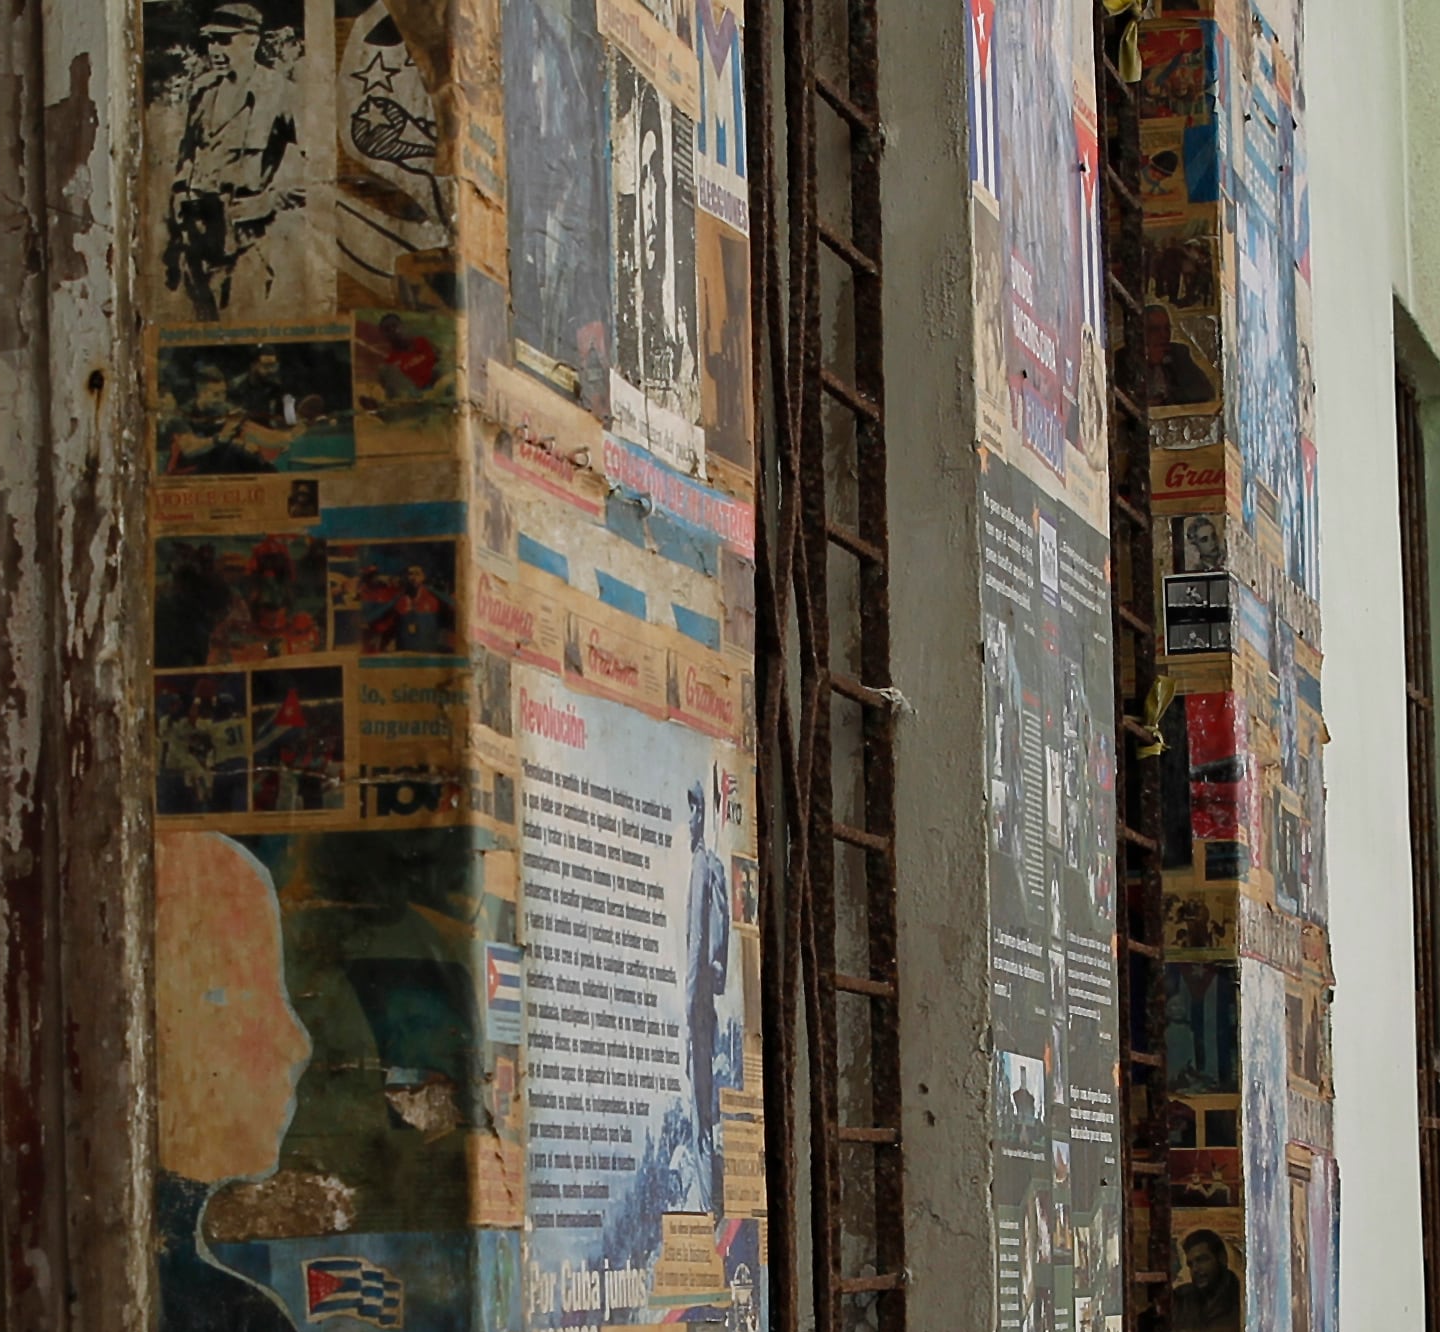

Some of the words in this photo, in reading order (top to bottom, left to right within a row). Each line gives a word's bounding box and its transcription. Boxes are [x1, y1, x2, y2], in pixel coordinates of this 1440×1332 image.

[530, 1259, 557, 1313] Por
[561, 1257, 601, 1313] Cuba
[603, 1256, 649, 1322] juntos
